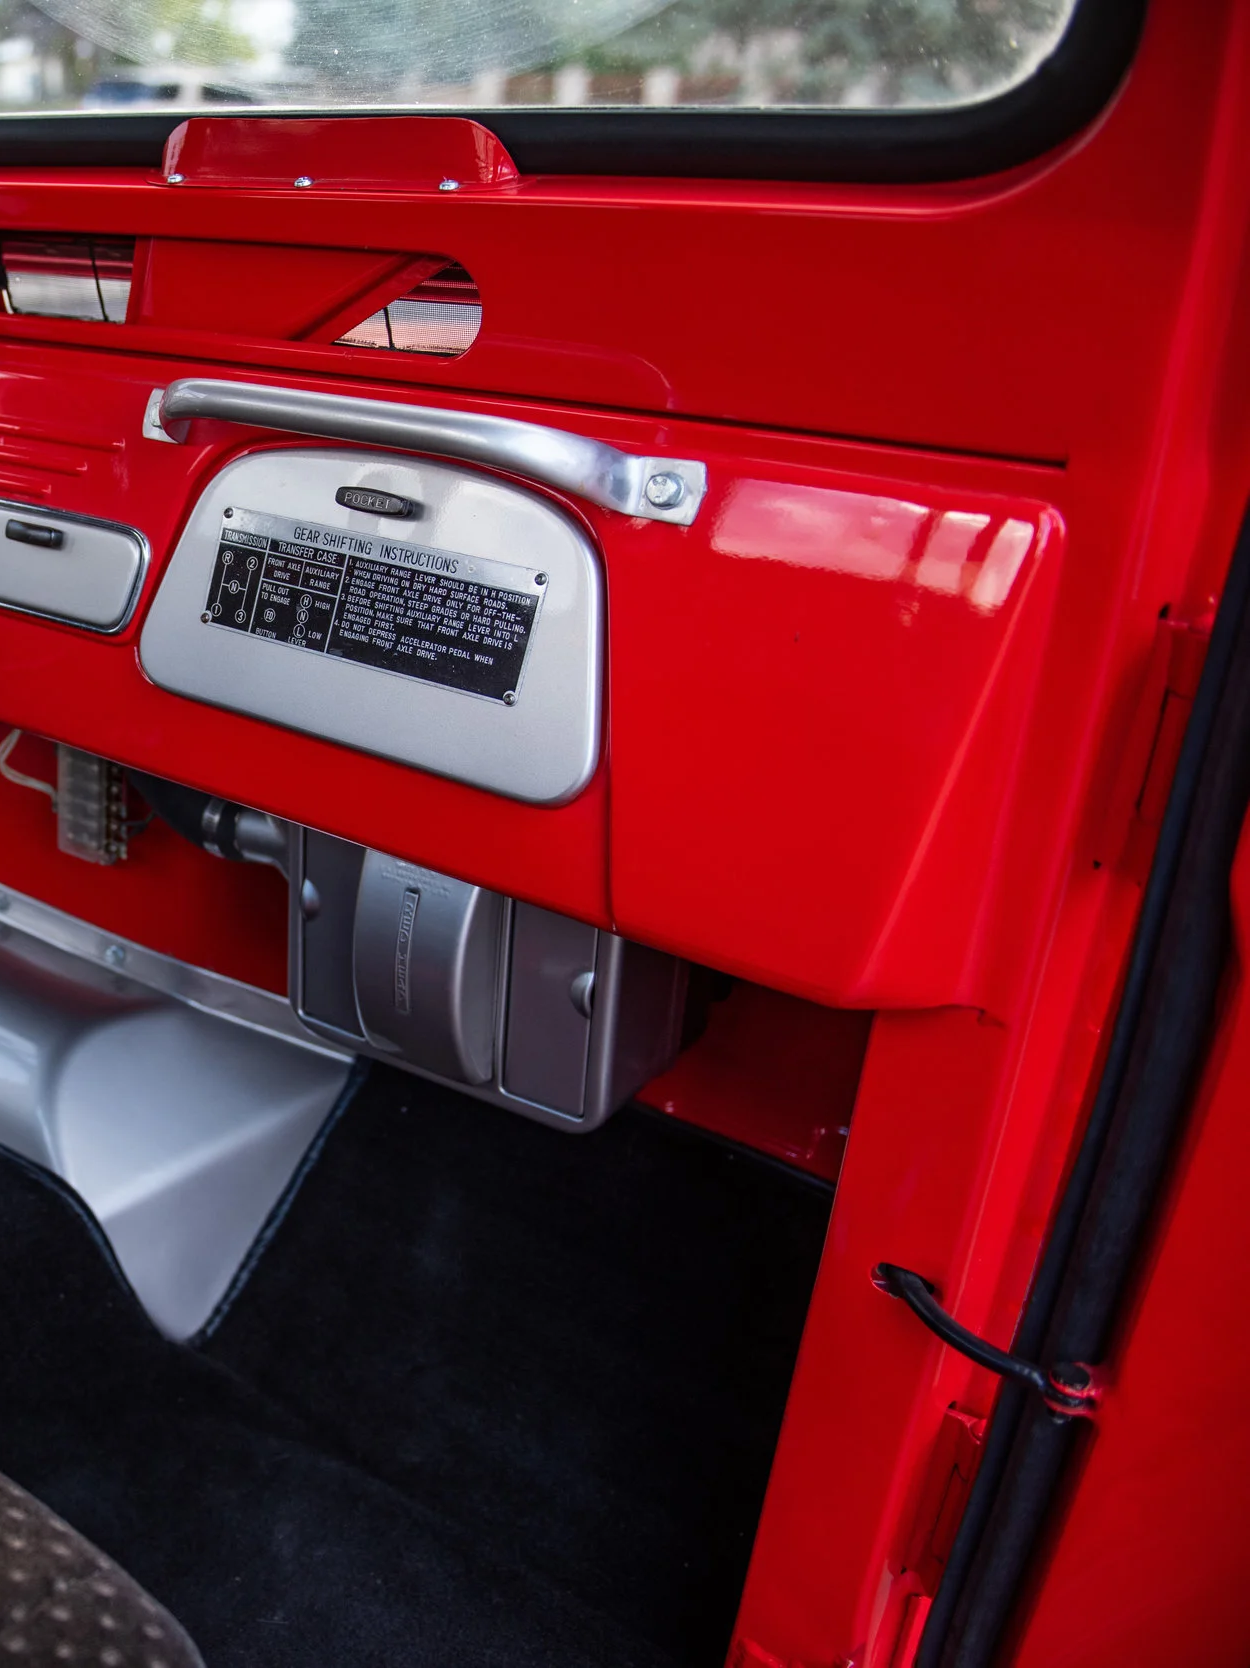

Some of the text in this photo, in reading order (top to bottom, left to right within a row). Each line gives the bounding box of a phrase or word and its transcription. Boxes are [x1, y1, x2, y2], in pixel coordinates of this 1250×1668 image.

[344, 492, 390, 509] POCKET
[225, 530, 267, 548] TRANSMISSION
[278, 542, 337, 563] TRANSFER CASE
[294, 527, 458, 573] GEAR SHIFTING INSTRUCTIONS
[268, 558, 300, 571] FRONT AXLE
[306, 566, 339, 580] AUXILIARY
[274, 570, 290, 580] DRIVE
[356, 561, 388, 574] AUXILIARY
[391, 568, 411, 578] RANGE
[415, 574, 436, 584] LEVER
[440, 579, 464, 592] SHOULD
[468, 585, 478, 594] BE
[481, 588, 488, 596] IN
[491, 589, 497, 597] H
[498, 591, 530, 605] POSITION
[262, 583, 289, 595] PULL OUT
[309, 579, 330, 590] RANGE
[354, 571, 370, 579] WHEN
[372, 574, 398, 586] DRIVING
[413, 582, 426, 592] DRY
[429, 586, 447, 596] HARD
[450, 591, 479, 603] SURFACE
[484, 598, 508, 610] ROADS.
[270, 594, 290, 605] ENGAGE
[352, 578, 375, 589] ENGAGE
[379, 585, 399, 596] FRONT
[403, 590, 419, 599] AXLE
[423, 594, 441, 605] DRIVE
[446, 599, 463, 609] ONLY
[467, 605, 480, 613] FOR
[315, 601, 330, 610] HIGH
[349, 586, 365, 596] ROAD
[408, 601, 428, 610] STEEP
[431, 605, 457, 618] GRADES
[461, 612, 470, 620] OR
[473, 615, 490, 625] HARD
[494, 620, 526, 634] PULLING.
[344, 613, 395, 631] ENGAGED FIRST.
[347, 595, 370, 606] BEFORE
[375, 602, 404, 614] SHIFTING
[407, 609, 440, 622] AUXILIARY
[443, 619, 464, 629] RANGE
[468, 624, 490, 635] LEVER
[494, 630, 510, 640] INTO
[256, 628, 276, 638] BUTTON
[308, 631, 322, 640] LOW
[376, 612, 393, 622] MAKE
[396, 616, 412, 626] SURE
[418, 621, 434, 631] THAT
[438, 626, 459, 637] FRONT
[462, 632, 479, 642] AXLE
[483, 637, 502, 648] DRIVE
[504, 642, 512, 650] IS
[288, 636, 306, 647] LEVER
[339, 631, 437, 660] ENGAGING FRONT AXLE DRIVE.
[341, 621, 350, 629] DO
[353, 624, 365, 632] NOT
[368, 627, 396, 640] DEPRESS
[401, 636, 446, 652] ACCELERATOR
[449, 648, 470, 660] PEDAL
[475, 654, 493, 665] WHEN
